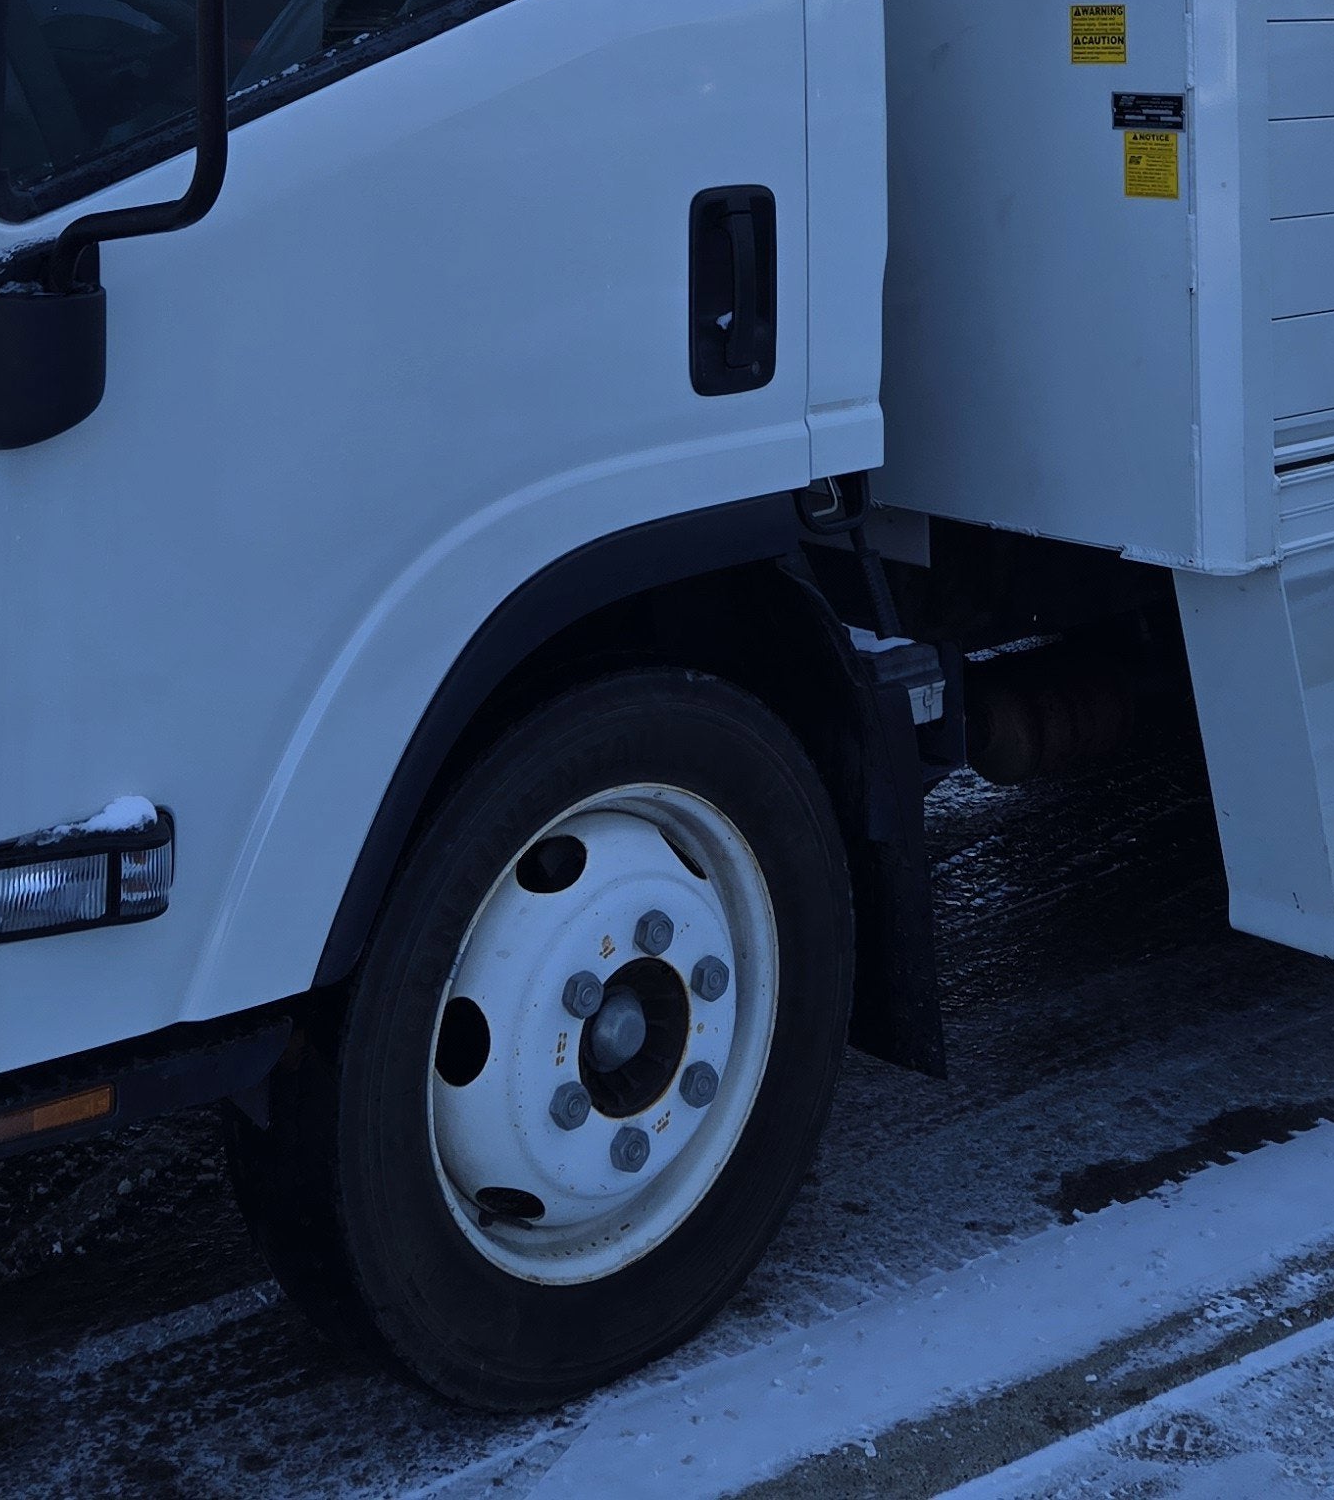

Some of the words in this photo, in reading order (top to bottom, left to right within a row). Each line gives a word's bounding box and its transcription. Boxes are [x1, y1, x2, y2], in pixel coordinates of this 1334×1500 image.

[1081, 6, 1123, 16] WARNING
[1082, 35, 1125, 45] CAUTION
[1139, 133, 1170, 142] NOTICE
